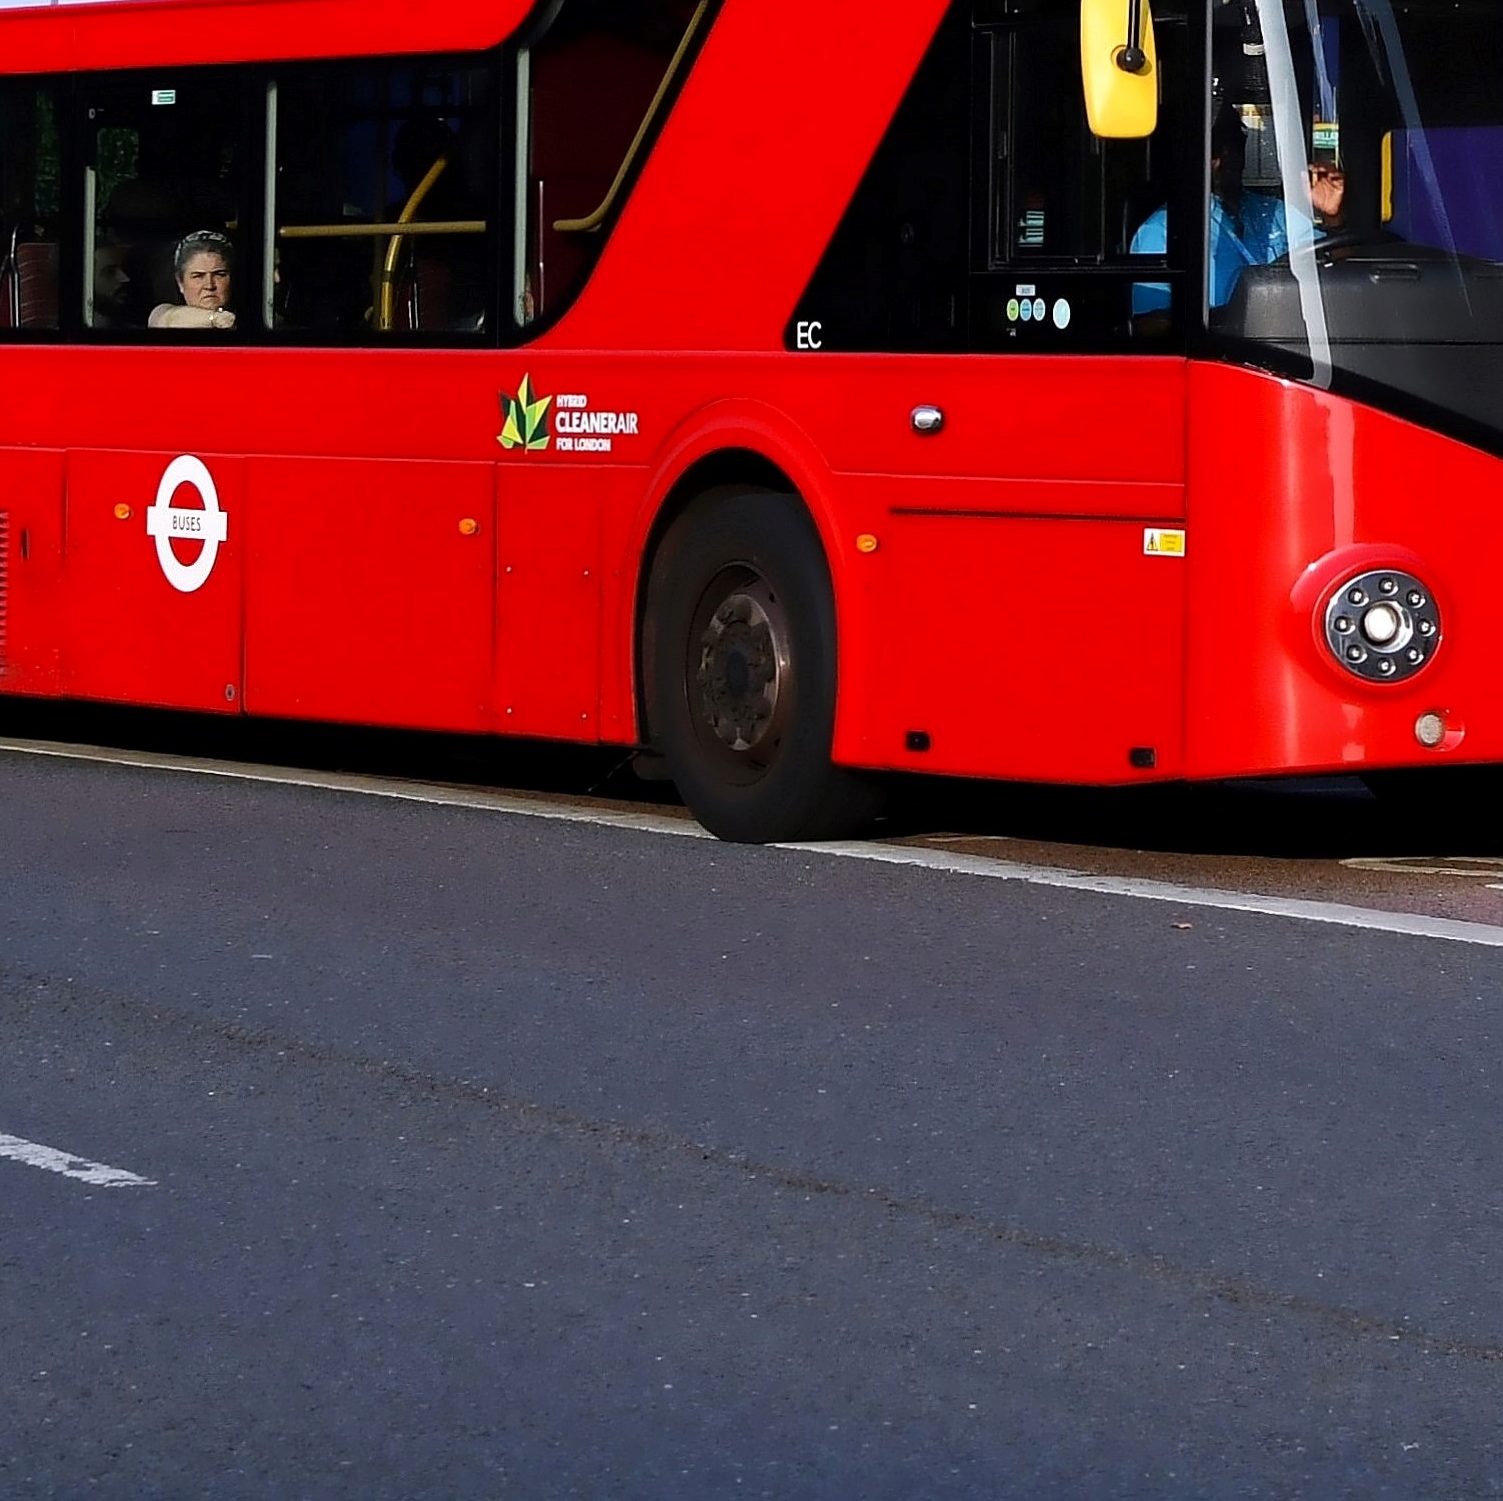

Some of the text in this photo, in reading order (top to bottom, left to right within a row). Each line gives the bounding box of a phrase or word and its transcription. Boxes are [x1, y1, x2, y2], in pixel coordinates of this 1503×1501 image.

[797, 321, 822, 350] EC
[556, 438, 611, 451] FOR LONDON
[173, 515, 201, 531] BUSES
